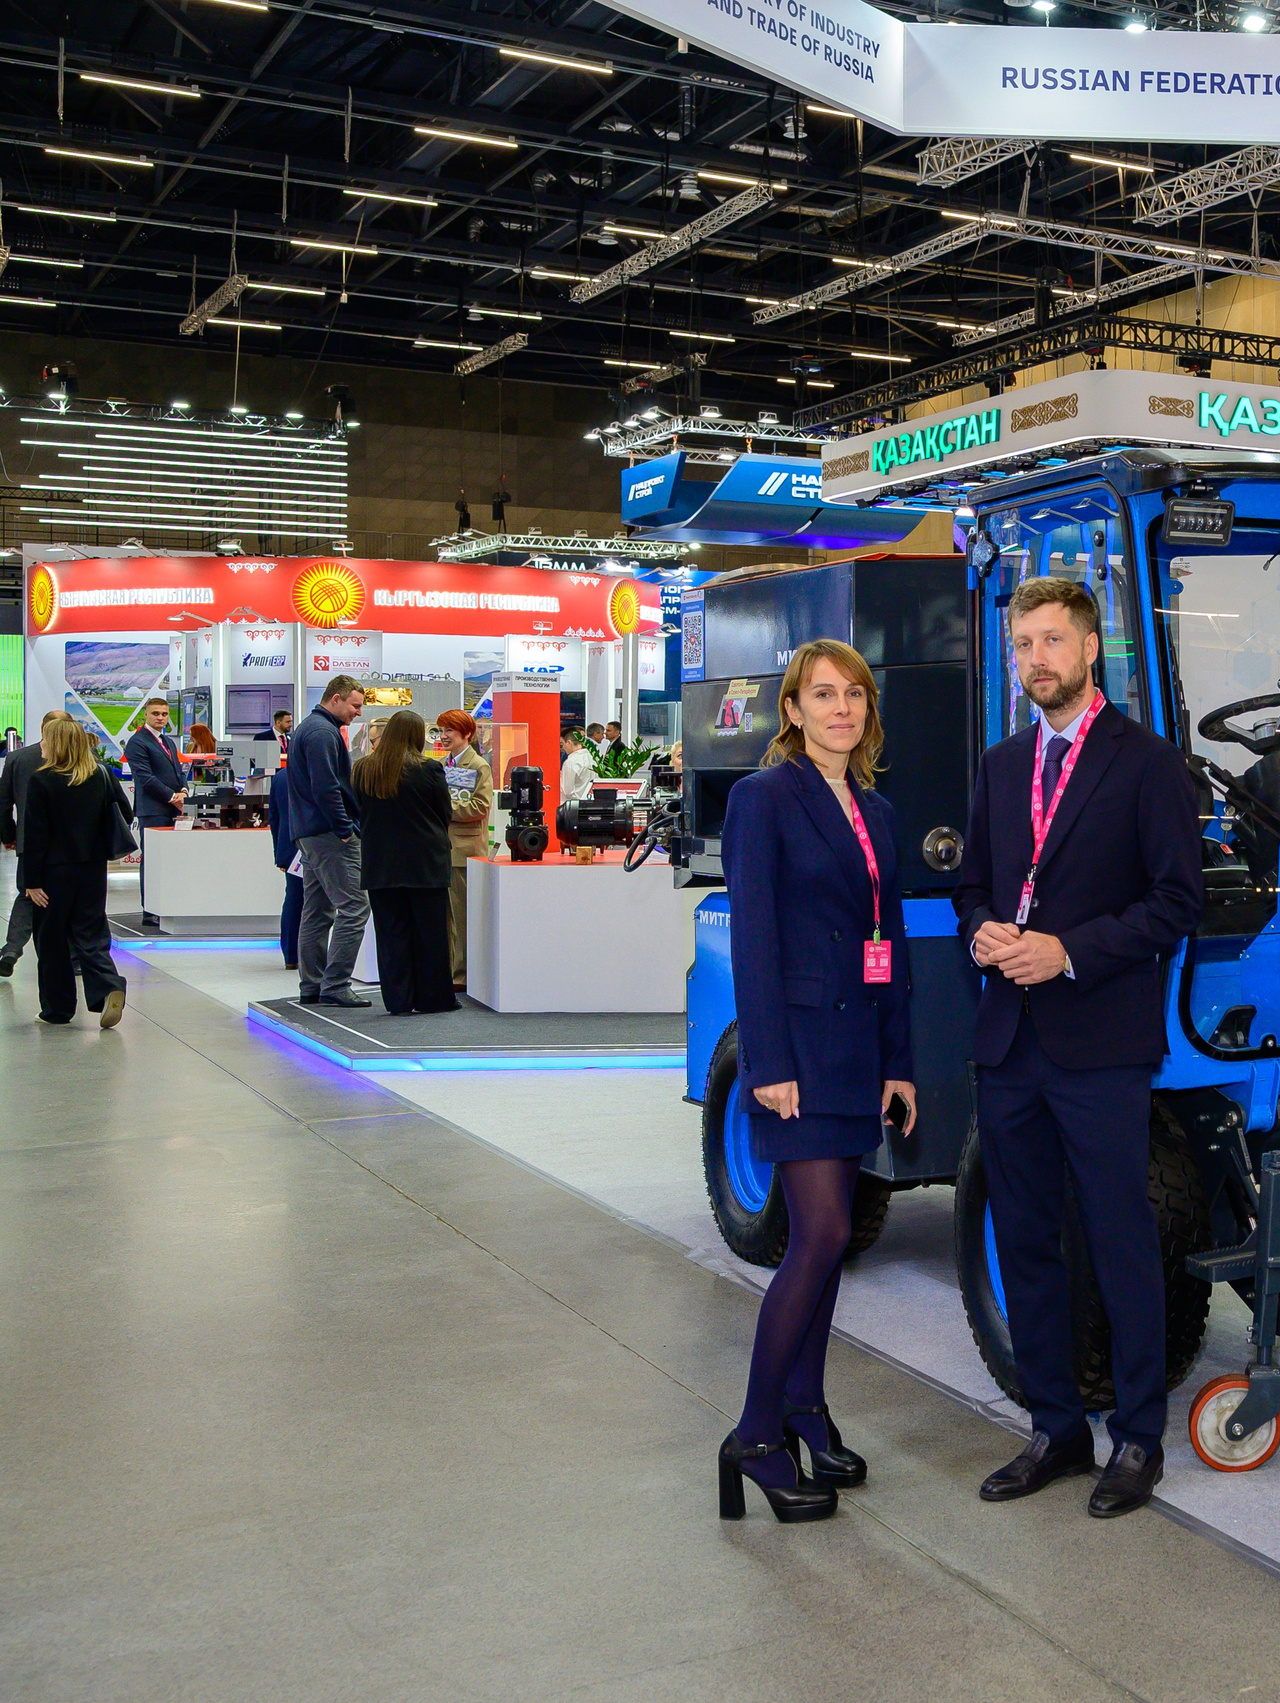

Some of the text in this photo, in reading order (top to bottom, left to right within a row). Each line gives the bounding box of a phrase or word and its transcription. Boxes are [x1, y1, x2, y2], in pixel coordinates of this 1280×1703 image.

[747, 6, 797, 47] TRADE
[801, 34, 820, 56] OF
[824, 43, 875, 84] RUSSIA
[787, 0, 881, 59] OF INDUSTRY
[1001, 67, 1130, 92] RUSSIAN
[871, 408, 1002, 476] ҚАЗАҚСТАН
[129, 588, 214, 605] РЕСПУБЛИКА
[374, 589, 479, 609] КЫРГЫЗСКАЯ
